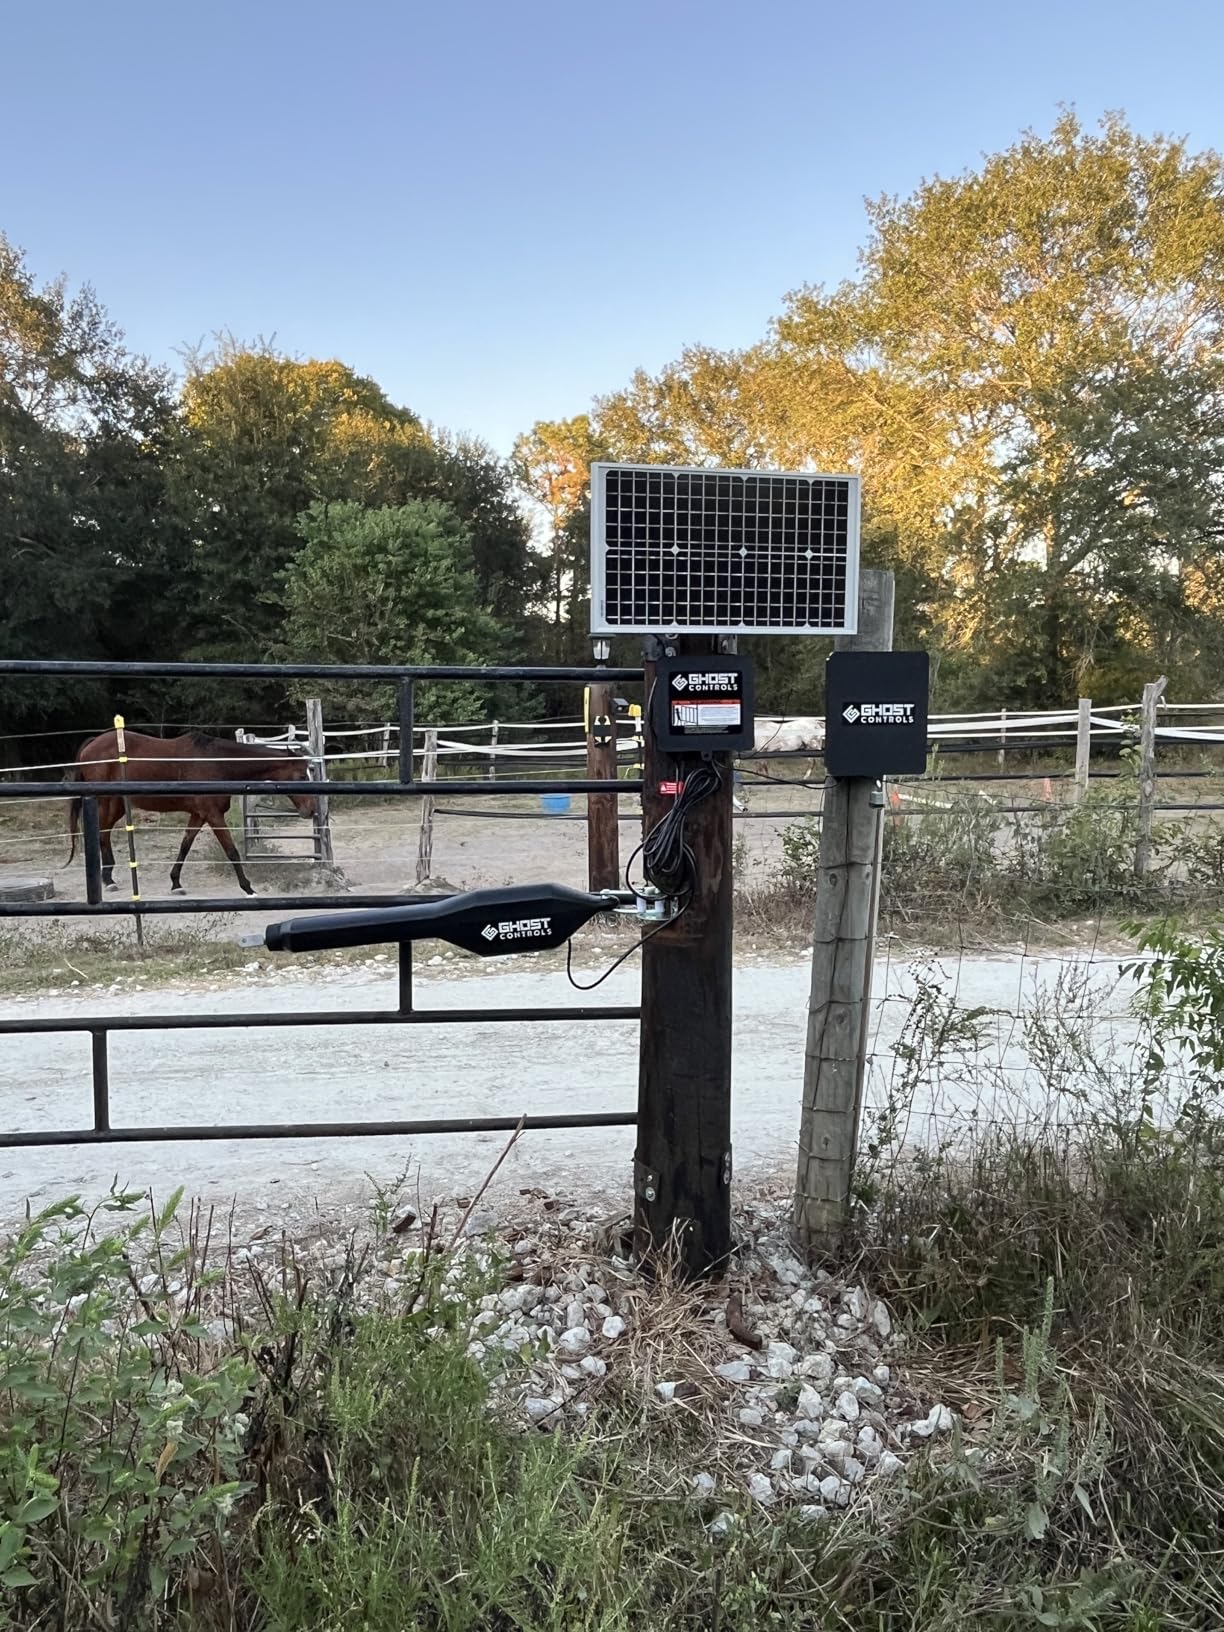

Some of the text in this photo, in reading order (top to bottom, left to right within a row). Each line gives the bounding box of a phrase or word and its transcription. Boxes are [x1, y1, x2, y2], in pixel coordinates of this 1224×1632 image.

[688, 673, 738, 684] GHOST
[860, 704, 915, 716] GHOST
[498, 917, 551, 933] GHOST
[500, 928, 552, 940] CONTROLS
